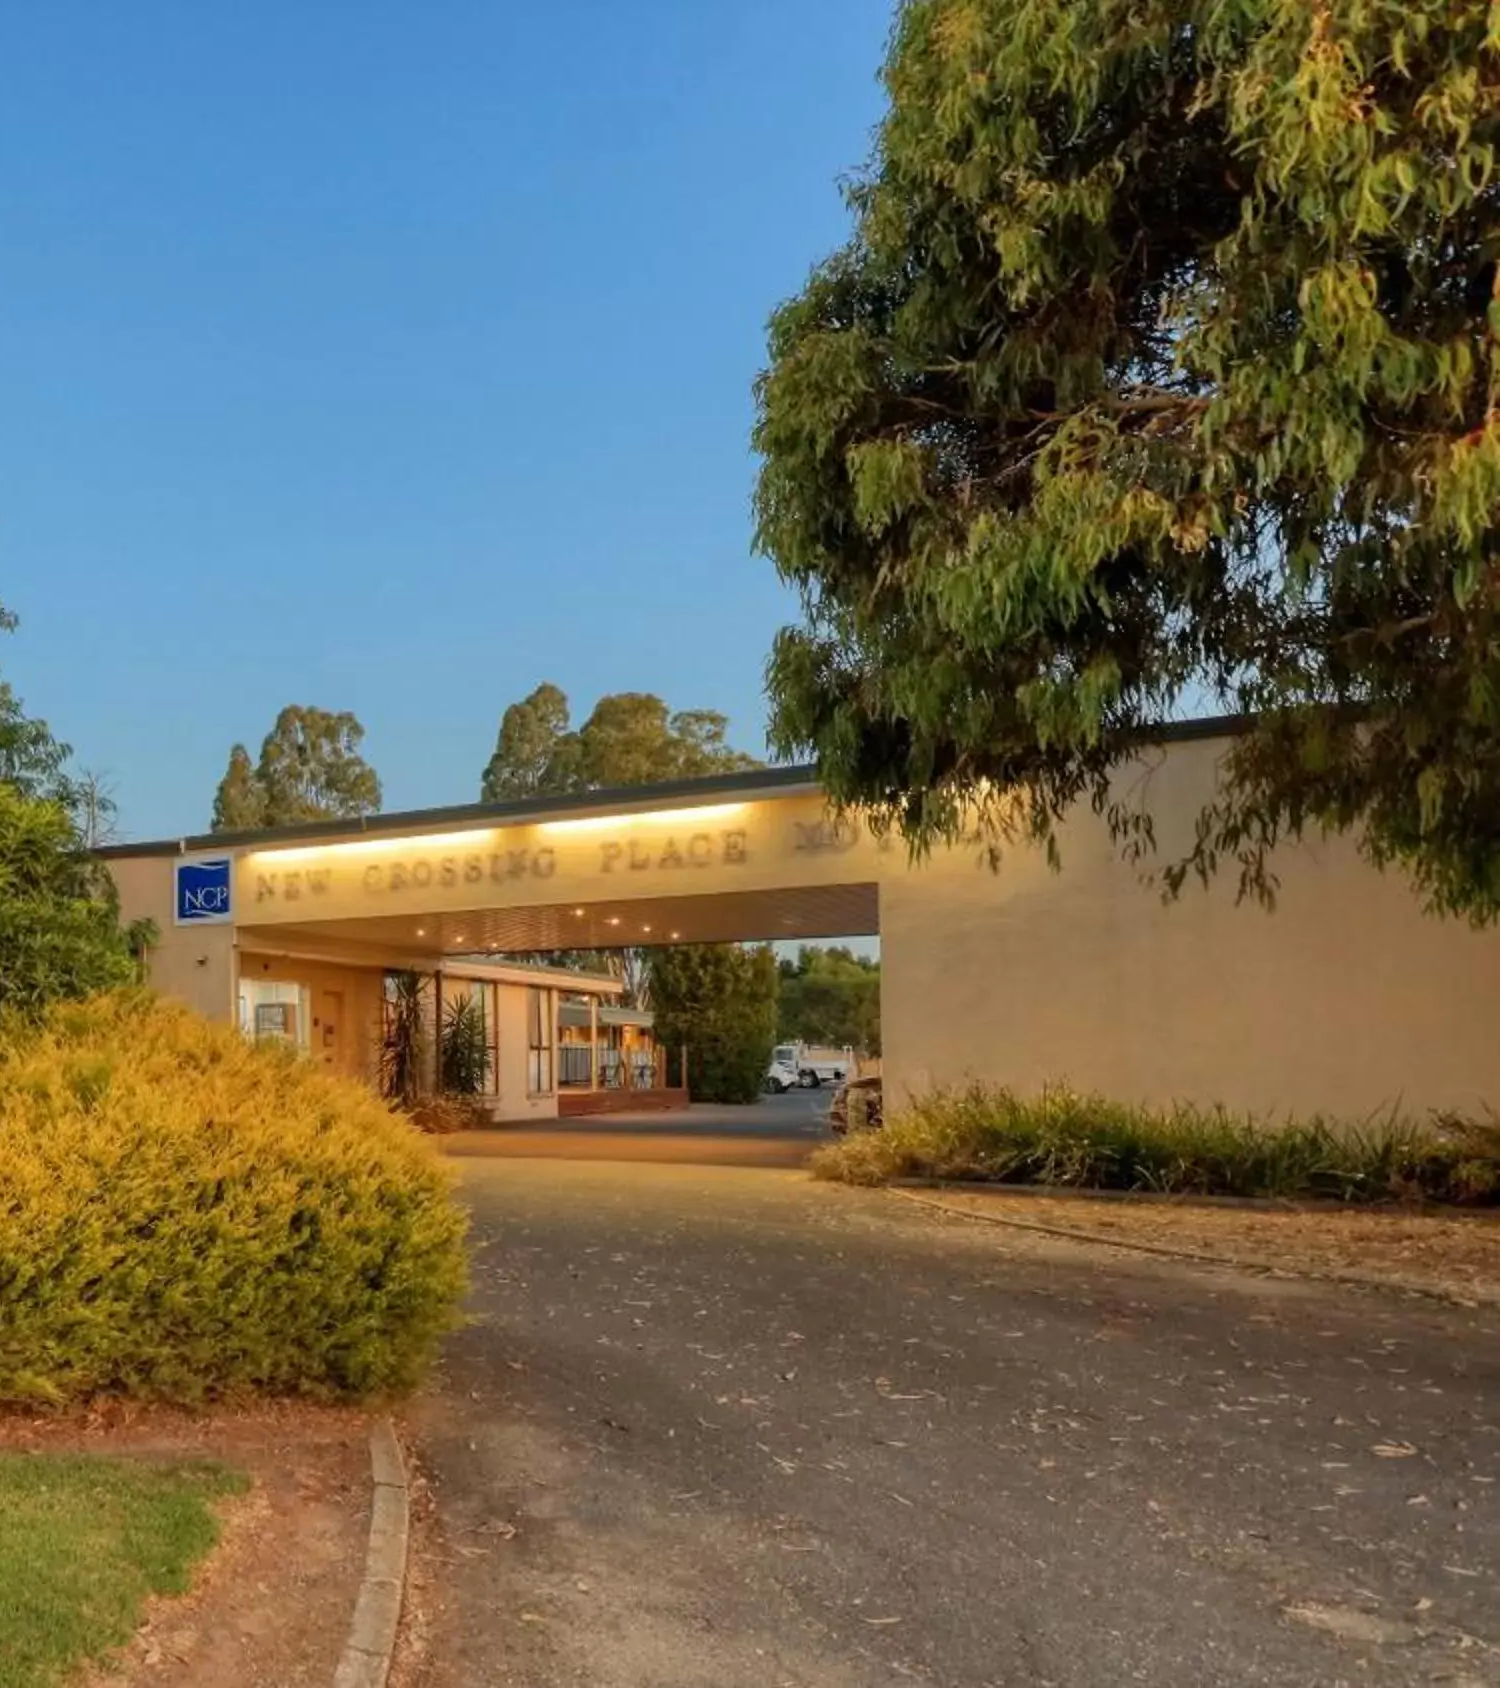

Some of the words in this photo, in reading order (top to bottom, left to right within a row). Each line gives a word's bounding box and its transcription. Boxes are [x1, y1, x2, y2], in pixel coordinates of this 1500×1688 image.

[256, 868, 332, 904] NEW
[362, 847, 557, 891] CROSSING
[599, 828, 747, 874] PLACE
[184, 886, 228, 909] NCP
